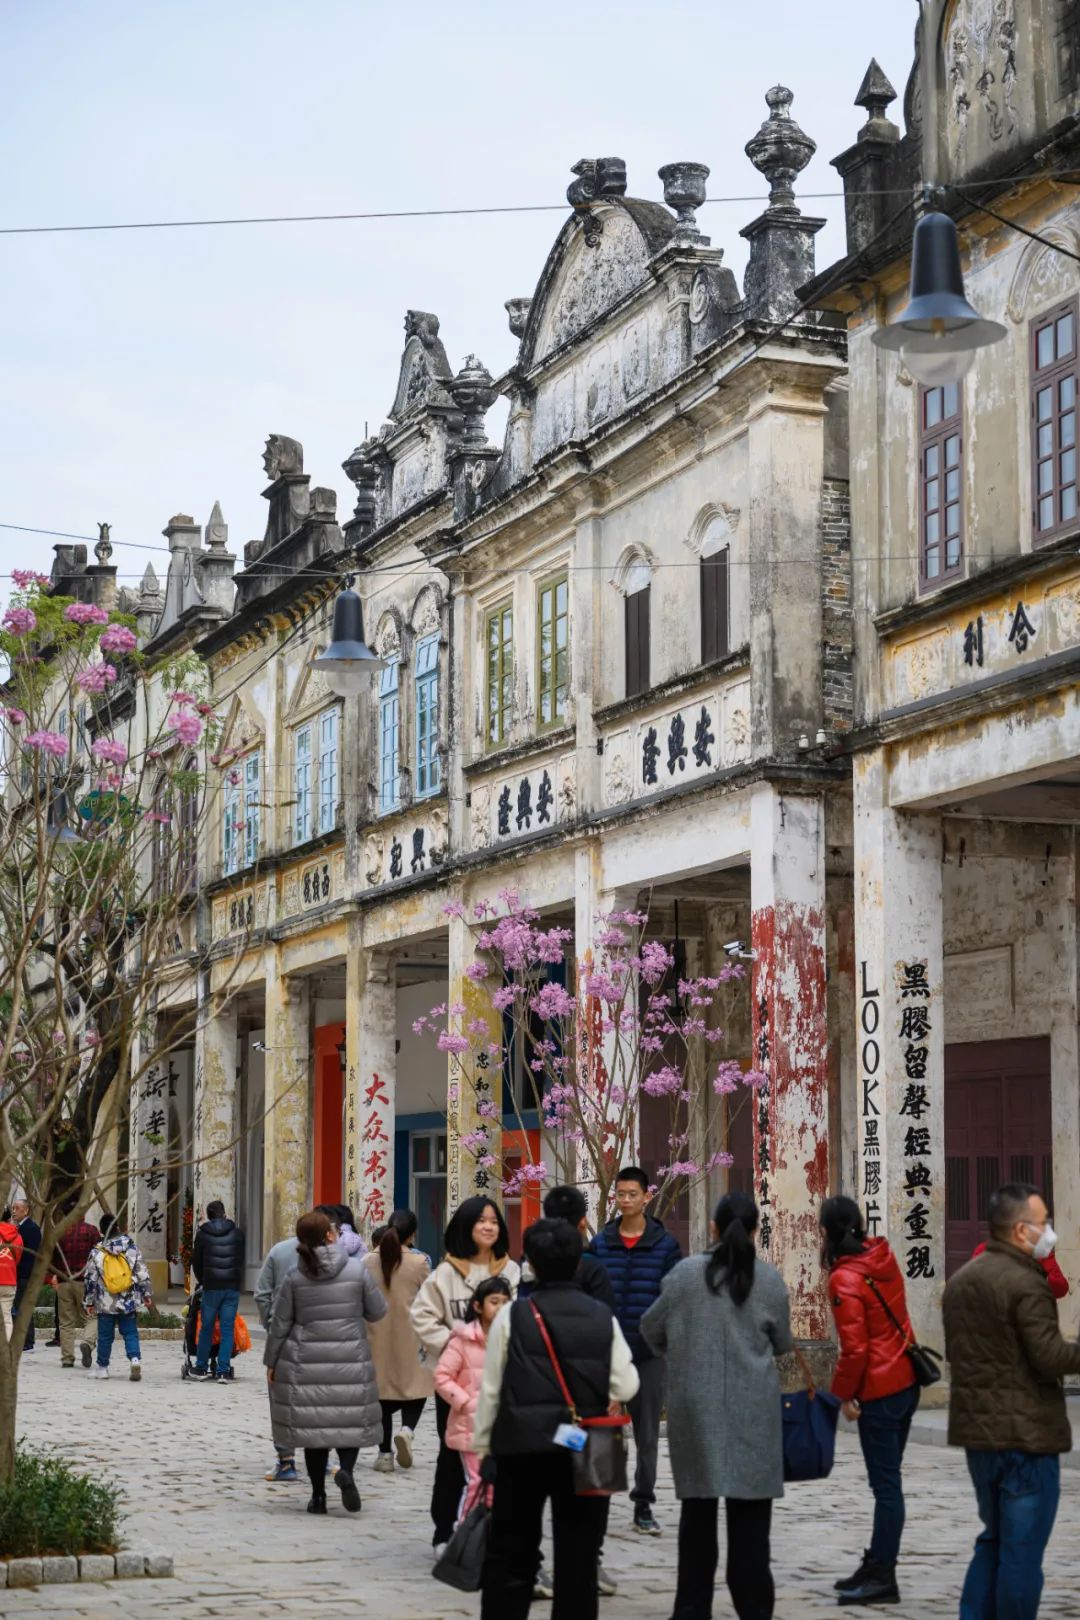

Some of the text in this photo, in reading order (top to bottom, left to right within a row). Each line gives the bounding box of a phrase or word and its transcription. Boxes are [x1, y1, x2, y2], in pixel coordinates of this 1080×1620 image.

[361, 1072, 390, 1224] 大众书店
[899, 962, 935, 1279] 黑膠留聲經典重現
